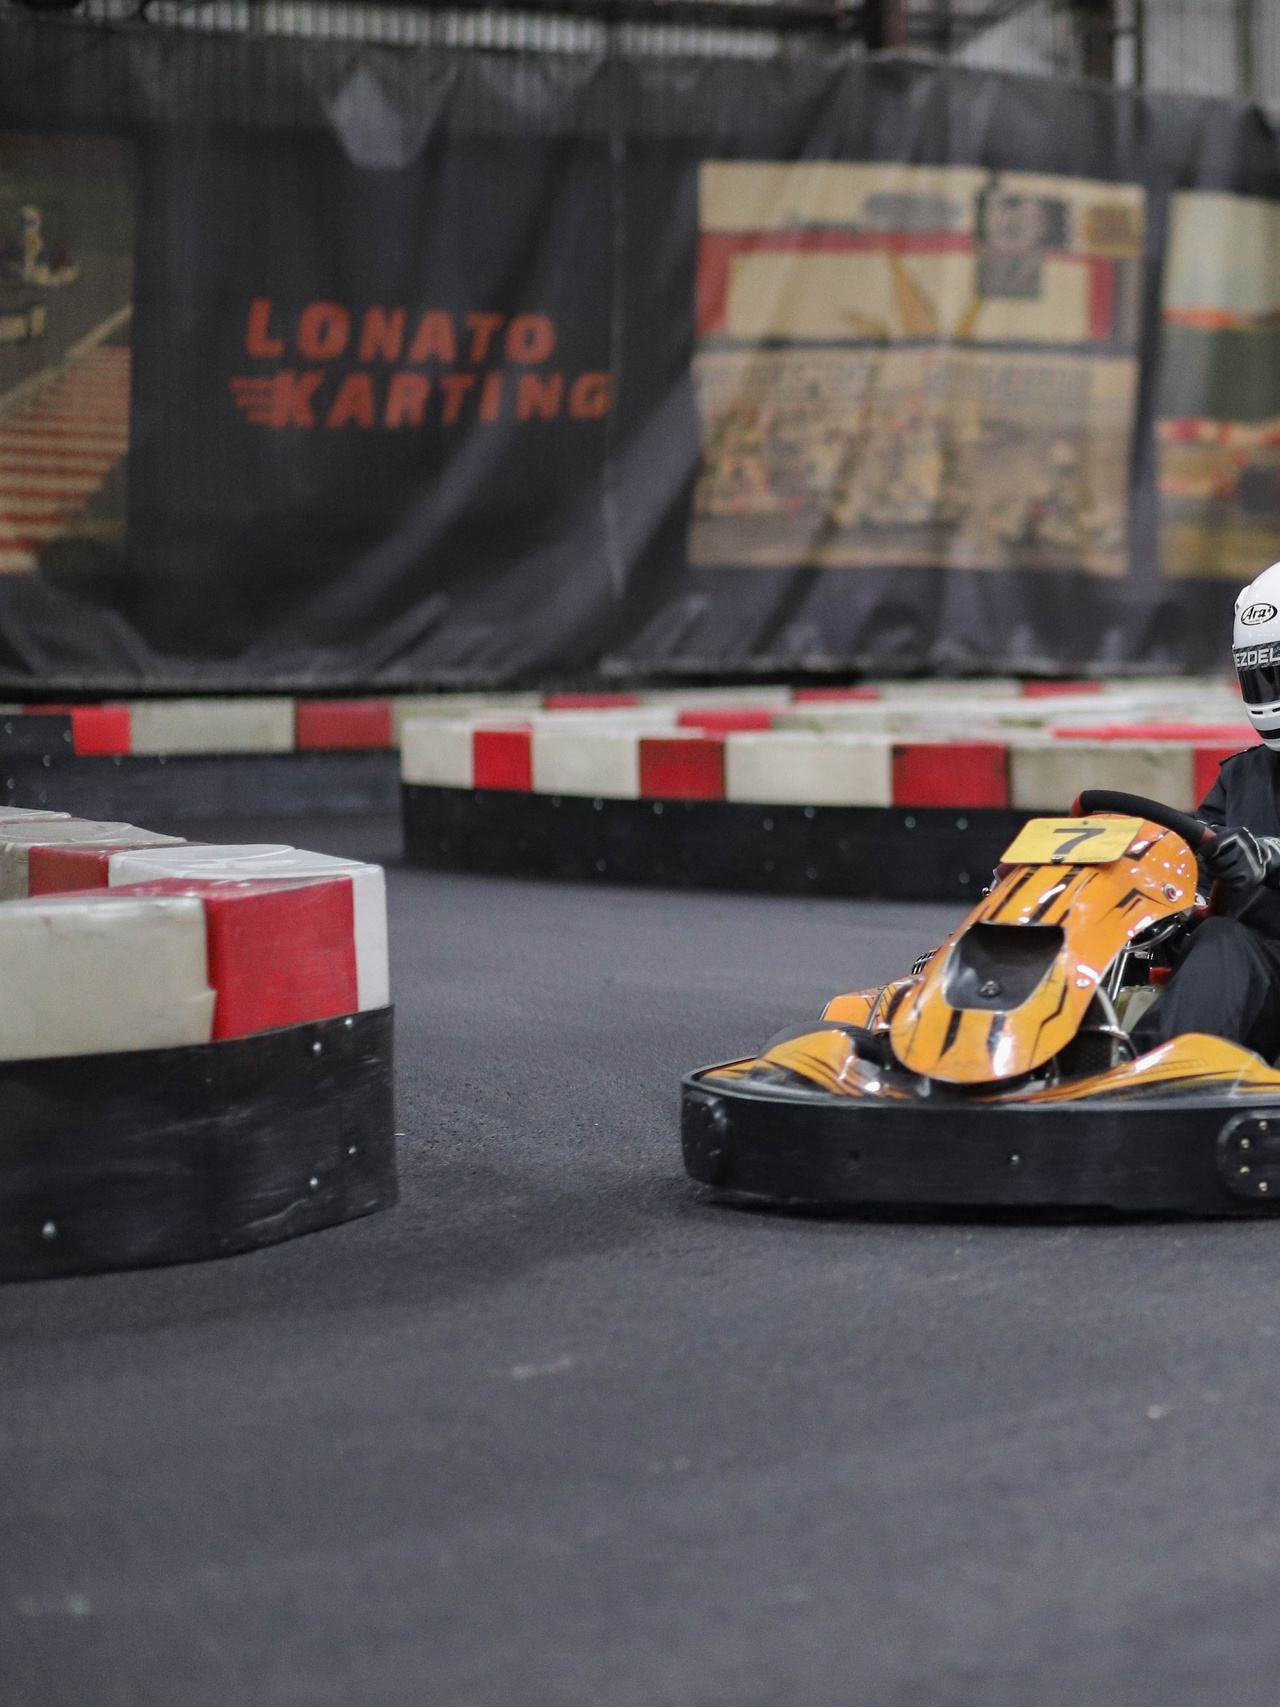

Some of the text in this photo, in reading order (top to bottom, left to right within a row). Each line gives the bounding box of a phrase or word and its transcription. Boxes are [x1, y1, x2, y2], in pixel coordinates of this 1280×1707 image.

[245, 298, 557, 365] LONATO
[229, 369, 614, 429] KARTING
[1053, 827, 1106, 856] 7
